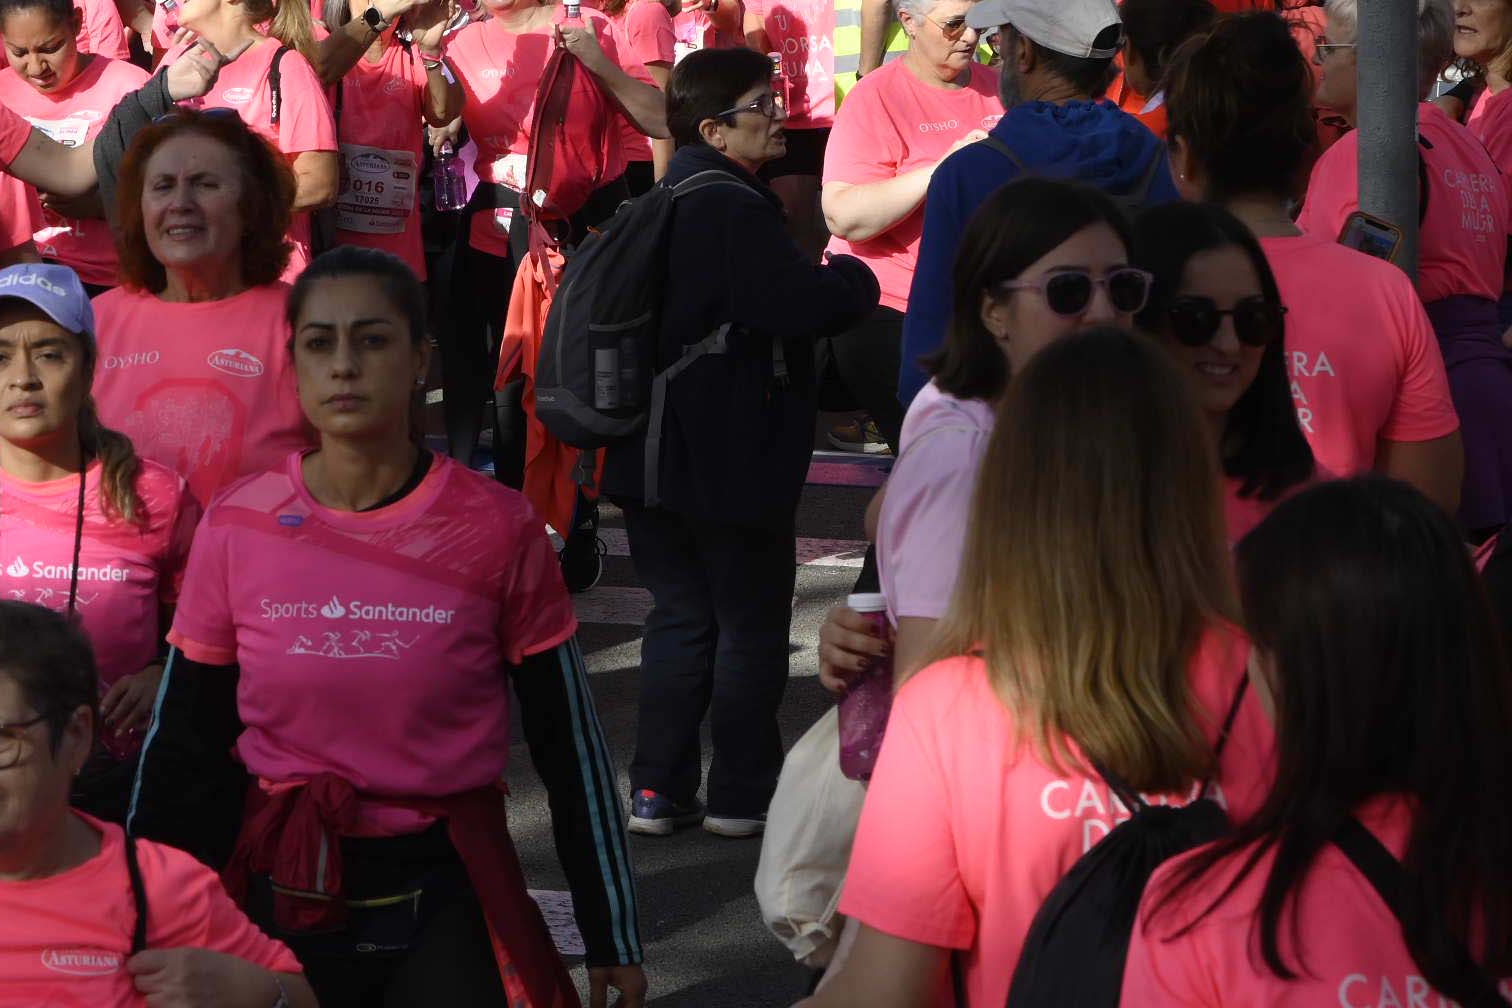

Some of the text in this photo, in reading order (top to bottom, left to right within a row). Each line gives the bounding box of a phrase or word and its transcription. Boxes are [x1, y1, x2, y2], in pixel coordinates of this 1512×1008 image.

[919, 119, 958, 133] OYSHO
[353, 179, 385, 194] 016
[104, 350, 161, 370] OYSHO
[260, 598, 456, 625] Sports Santander
[46, 949, 122, 969] ASTURIANA
